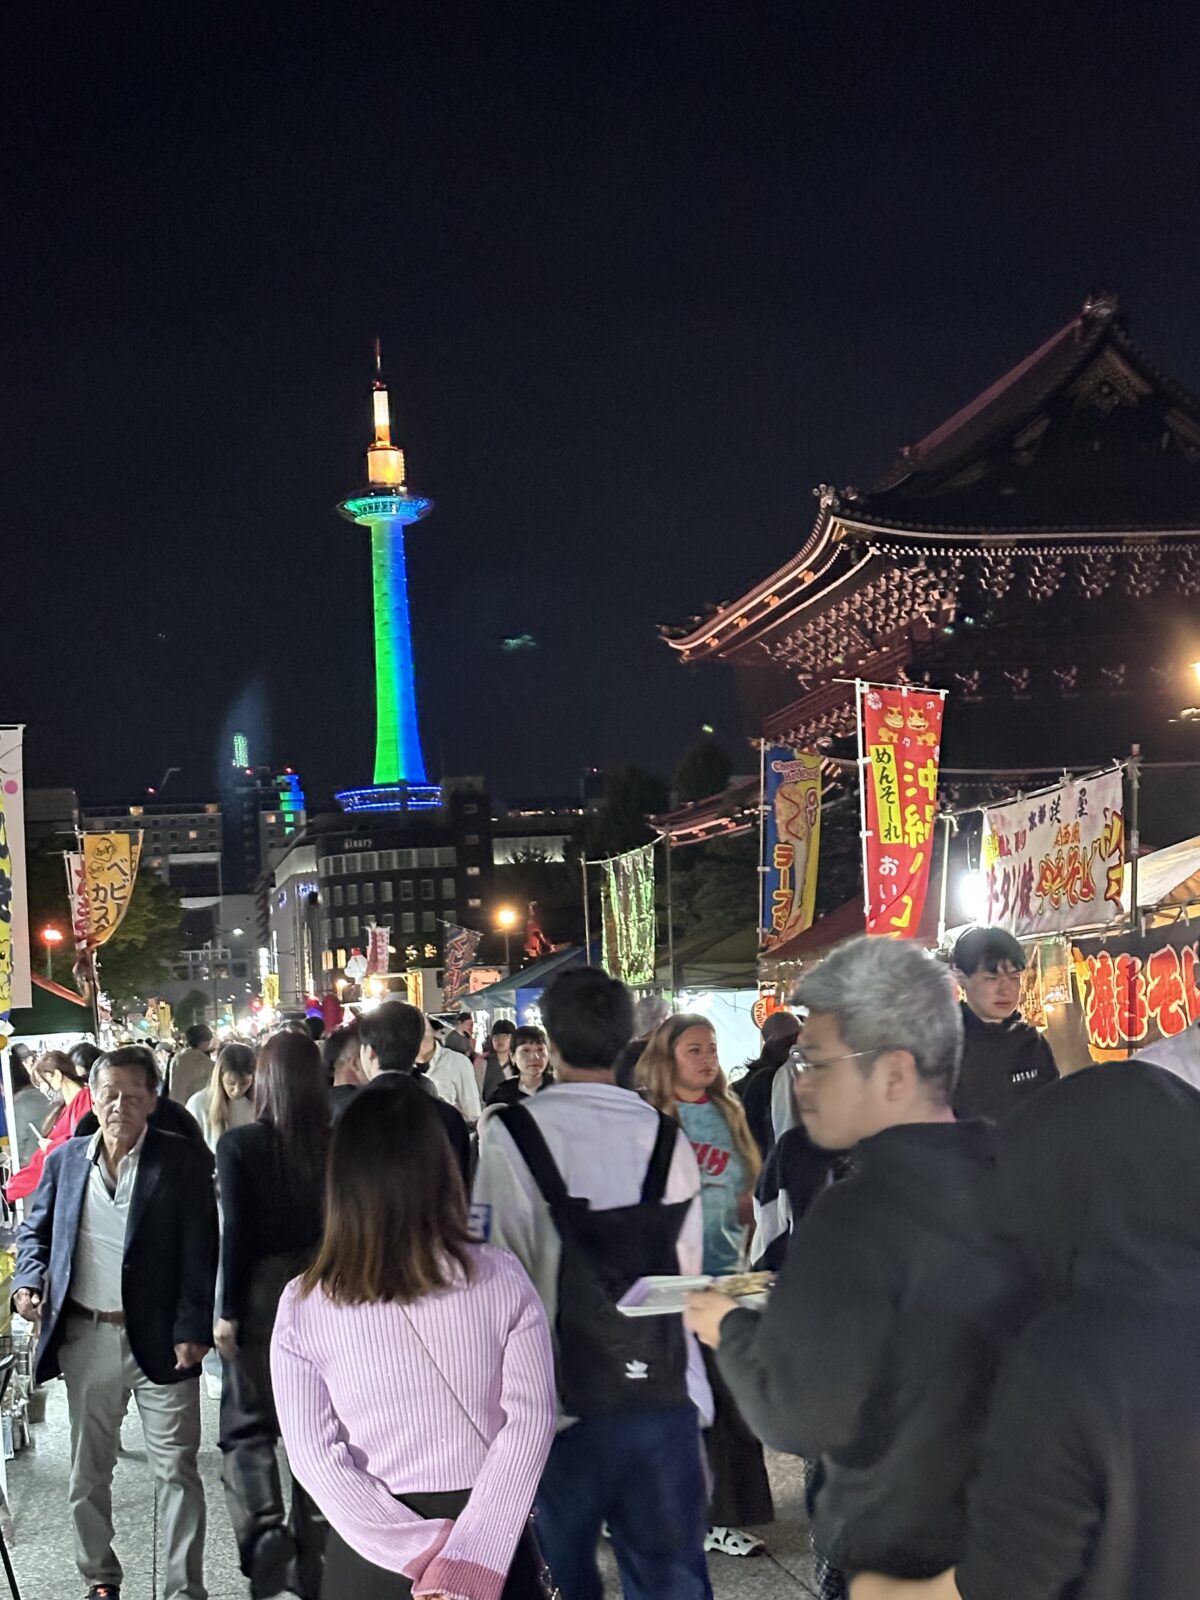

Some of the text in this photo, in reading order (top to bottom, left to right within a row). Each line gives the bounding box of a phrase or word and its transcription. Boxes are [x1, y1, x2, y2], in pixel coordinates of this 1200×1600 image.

[875, 747, 901, 842] めんそーれ
